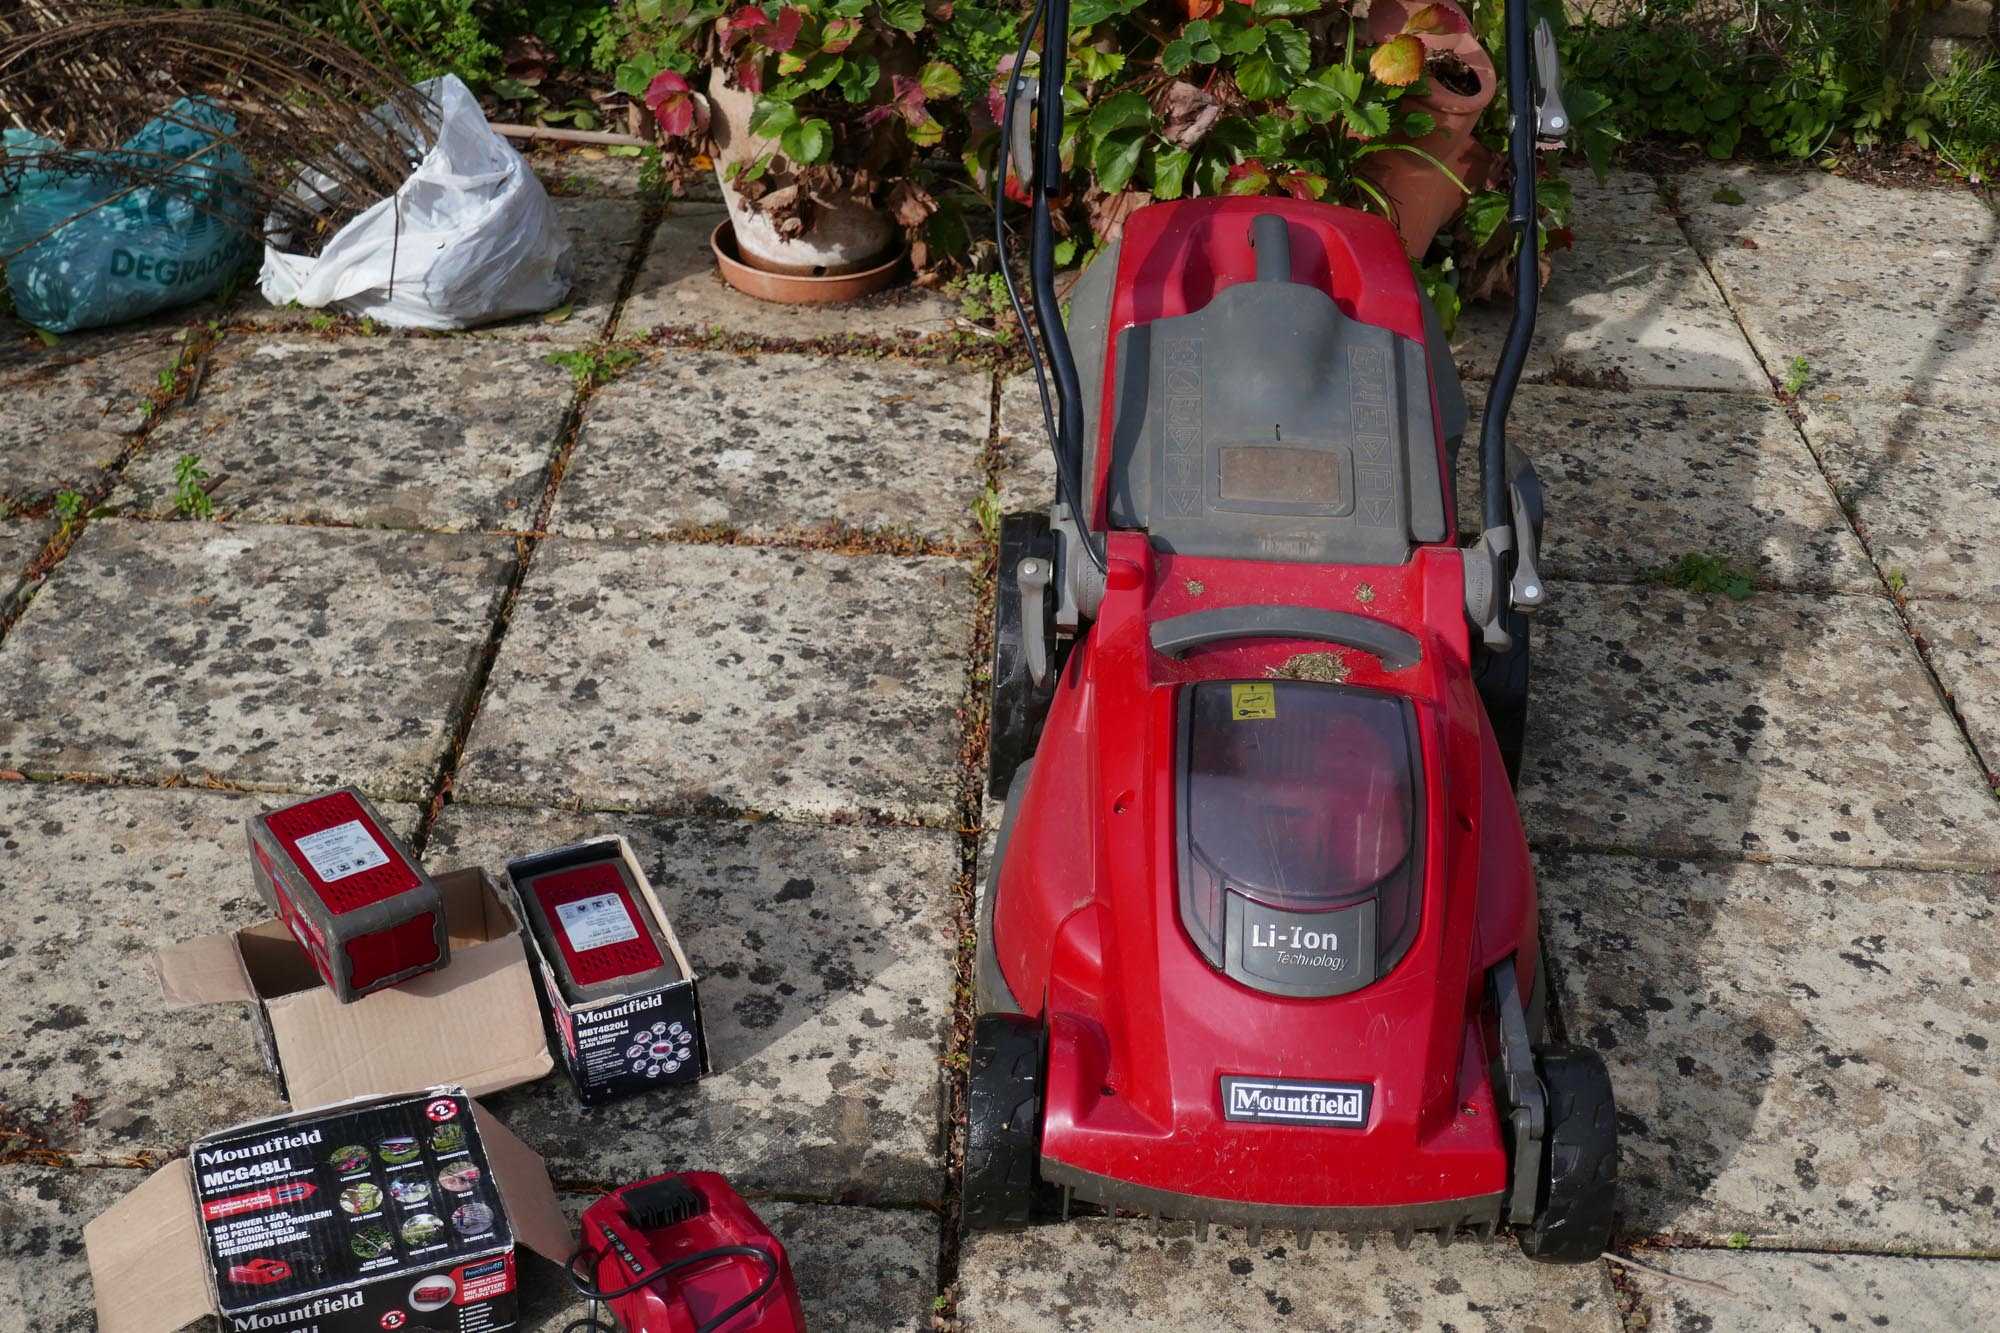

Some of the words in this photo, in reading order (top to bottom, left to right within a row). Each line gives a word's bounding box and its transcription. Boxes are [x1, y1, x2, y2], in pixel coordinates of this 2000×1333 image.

[1252, 924, 1338, 951] Li-Ion
[1277, 950, 1348, 971] Technology
[577, 994, 663, 1026] Mountfield
[436, 1105, 449, 1115] 2
[1236, 1088, 1358, 1115] Mountfield
[200, 1129, 322, 1167] Mountfield
[214, 1225, 228, 1234] NO
[230, 1217, 263, 1230] POWER
[265, 1211, 291, 1223] LEAD,
[216, 1233, 230, 1242] NO
[232, 1225, 269, 1238] PETROL,
[271, 1220, 284, 1229] NO
[286, 1209, 333, 1226] PROBLEM!
[217, 1240, 236, 1249] THE
[237, 1226, 295, 1246] MOUNTFIELD
[219, 1240, 275, 1257] FREEDOM48
[276, 1231, 311, 1245] RANGE.
[234, 1291, 365, 1332] Mountfield
[388, 1314, 399, 1324] 2
